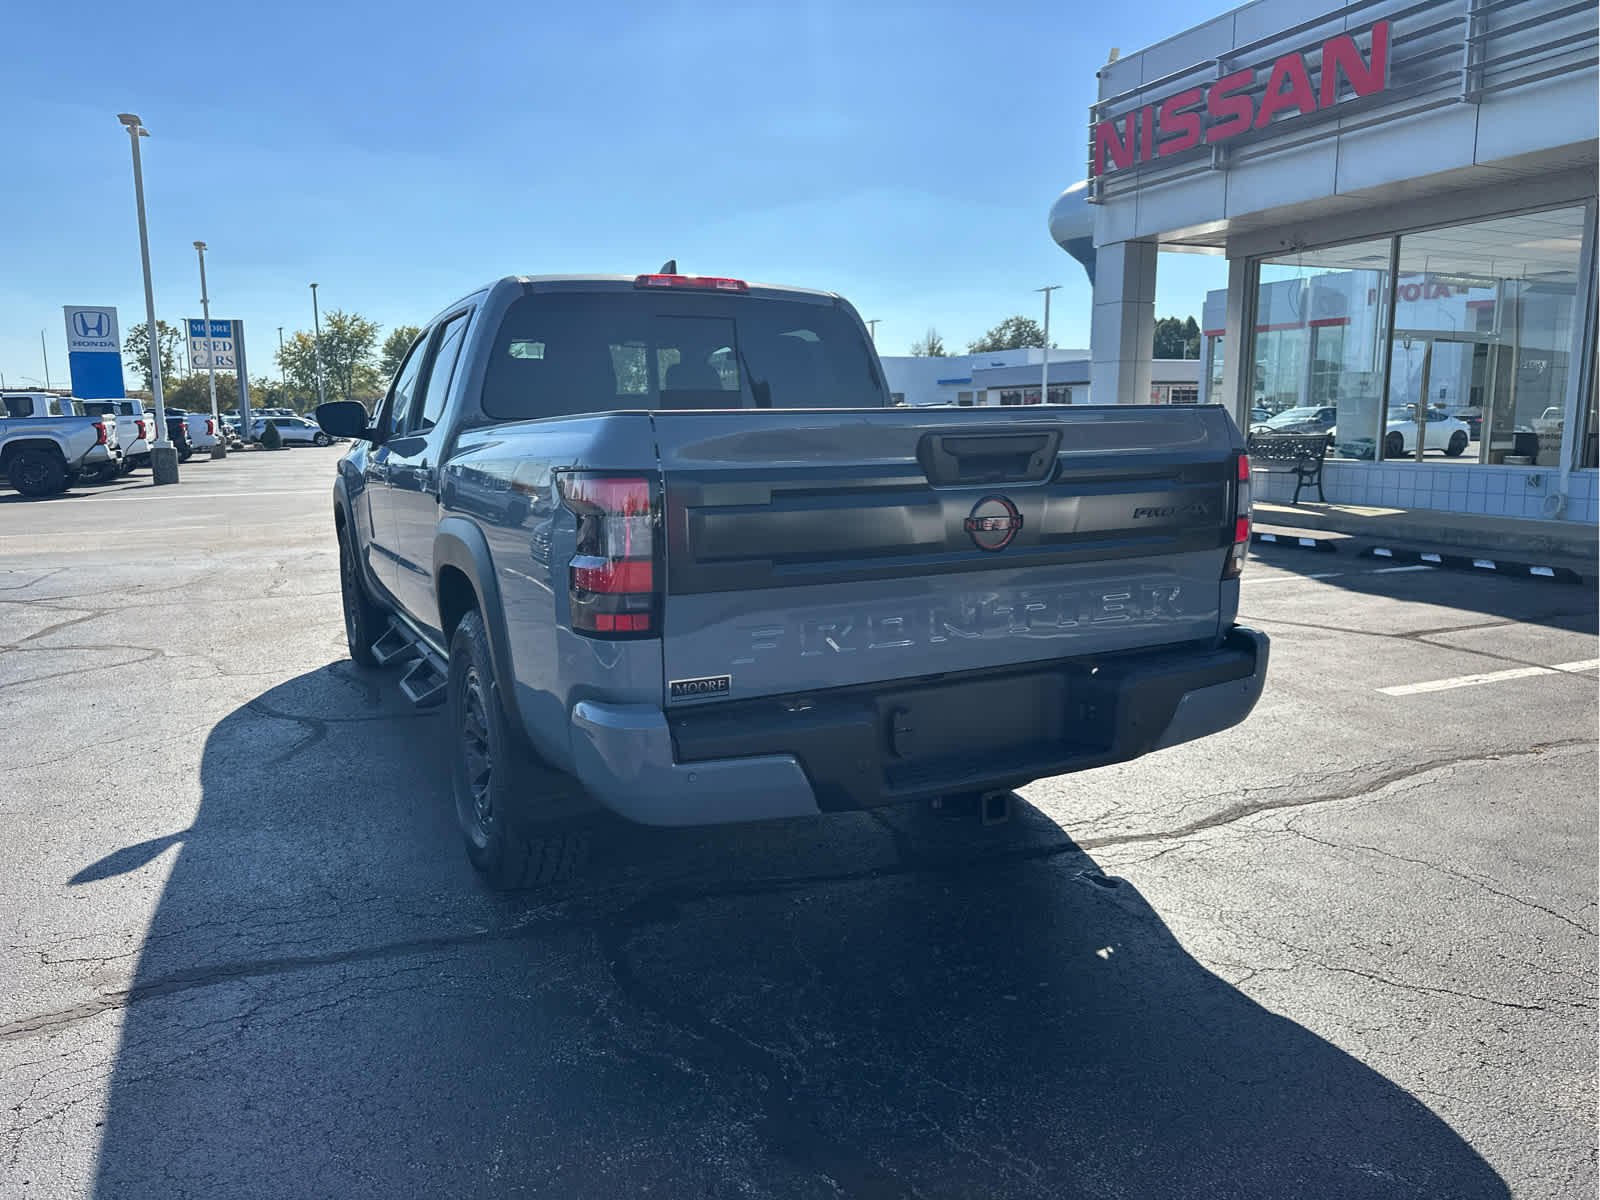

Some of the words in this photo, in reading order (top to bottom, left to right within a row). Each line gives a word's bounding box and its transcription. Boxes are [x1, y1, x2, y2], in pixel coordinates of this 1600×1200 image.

[1094, 21, 1389, 176] NISSAN
[1368, 283, 1451, 306] TOTA
[193, 341, 232, 351] USED
[193, 355, 233, 366] CRS
[966, 519, 1021, 530] NISSAN
[729, 584, 1182, 664] FRONTIER
[673, 680, 726, 695] MOORE
